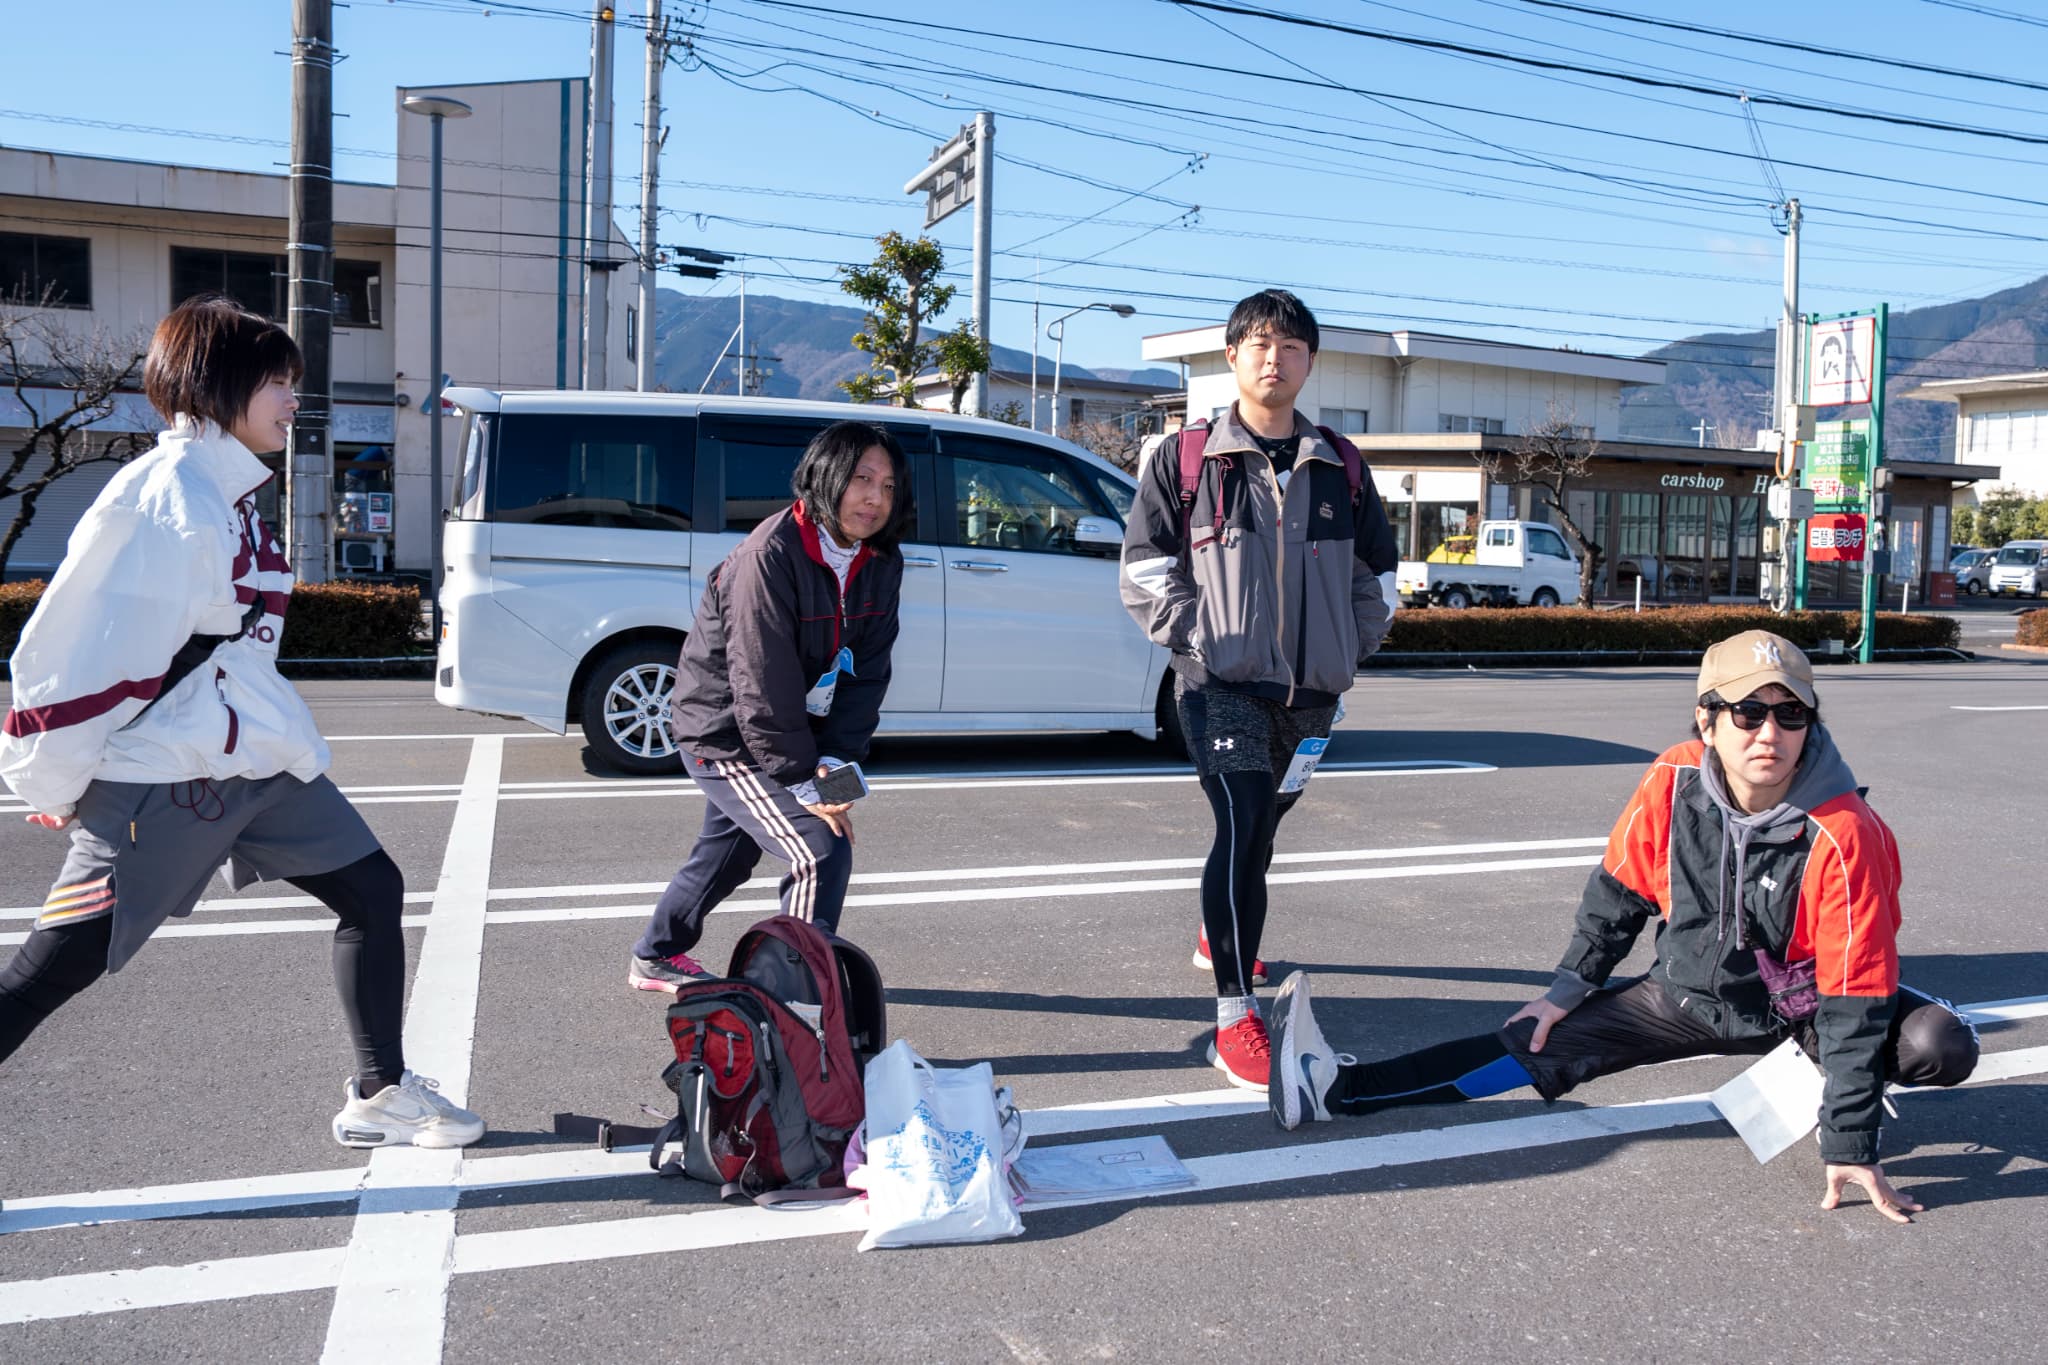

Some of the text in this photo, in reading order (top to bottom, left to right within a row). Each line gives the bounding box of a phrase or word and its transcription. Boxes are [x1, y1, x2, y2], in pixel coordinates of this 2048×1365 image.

[1660, 472, 1724, 490] carshop
[1811, 528, 1862, 547] 日替りランチ
